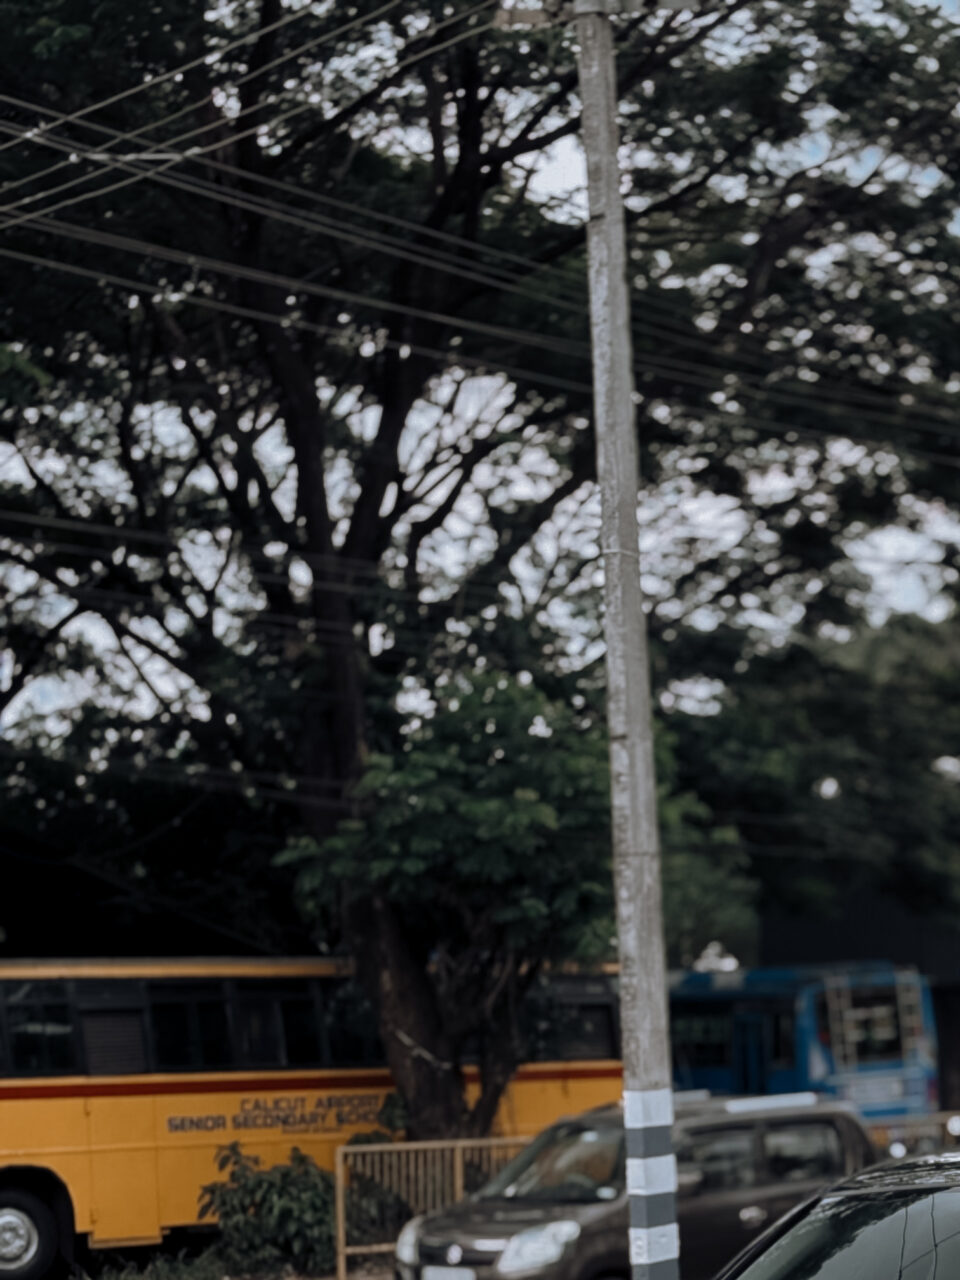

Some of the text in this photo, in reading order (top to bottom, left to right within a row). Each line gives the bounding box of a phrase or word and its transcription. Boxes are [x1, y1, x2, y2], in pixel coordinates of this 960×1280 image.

[240, 1098, 306, 1112] CALICUT
[167, 1116, 227, 1132] SENIOR
[232, 1111, 329, 1128] SECONDARY
